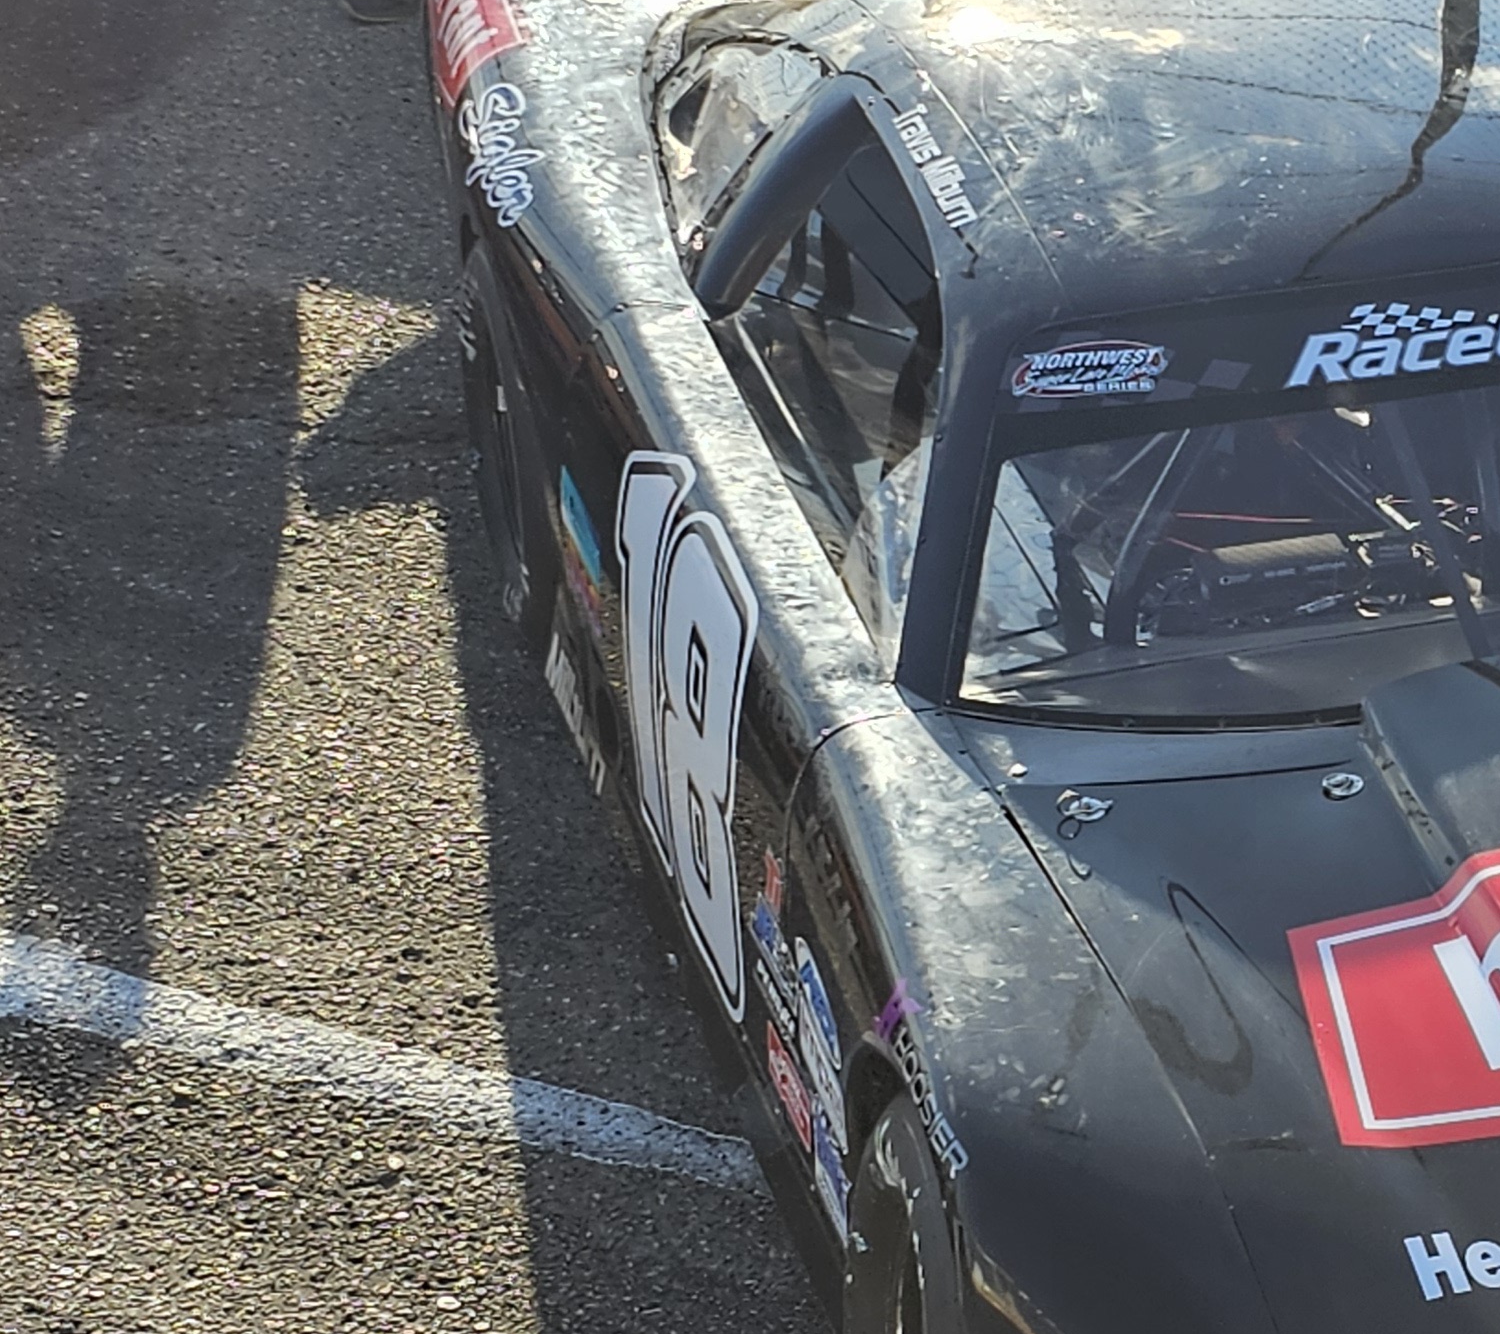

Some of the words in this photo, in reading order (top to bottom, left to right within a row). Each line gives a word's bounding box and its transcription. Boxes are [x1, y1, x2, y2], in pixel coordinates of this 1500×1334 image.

[891, 103, 942, 164] Travis
[1023, 346, 1165, 370] NORTHWEST
[615, 450, 760, 1023] 18
[894, 1027, 970, 1179] HOOSIER
